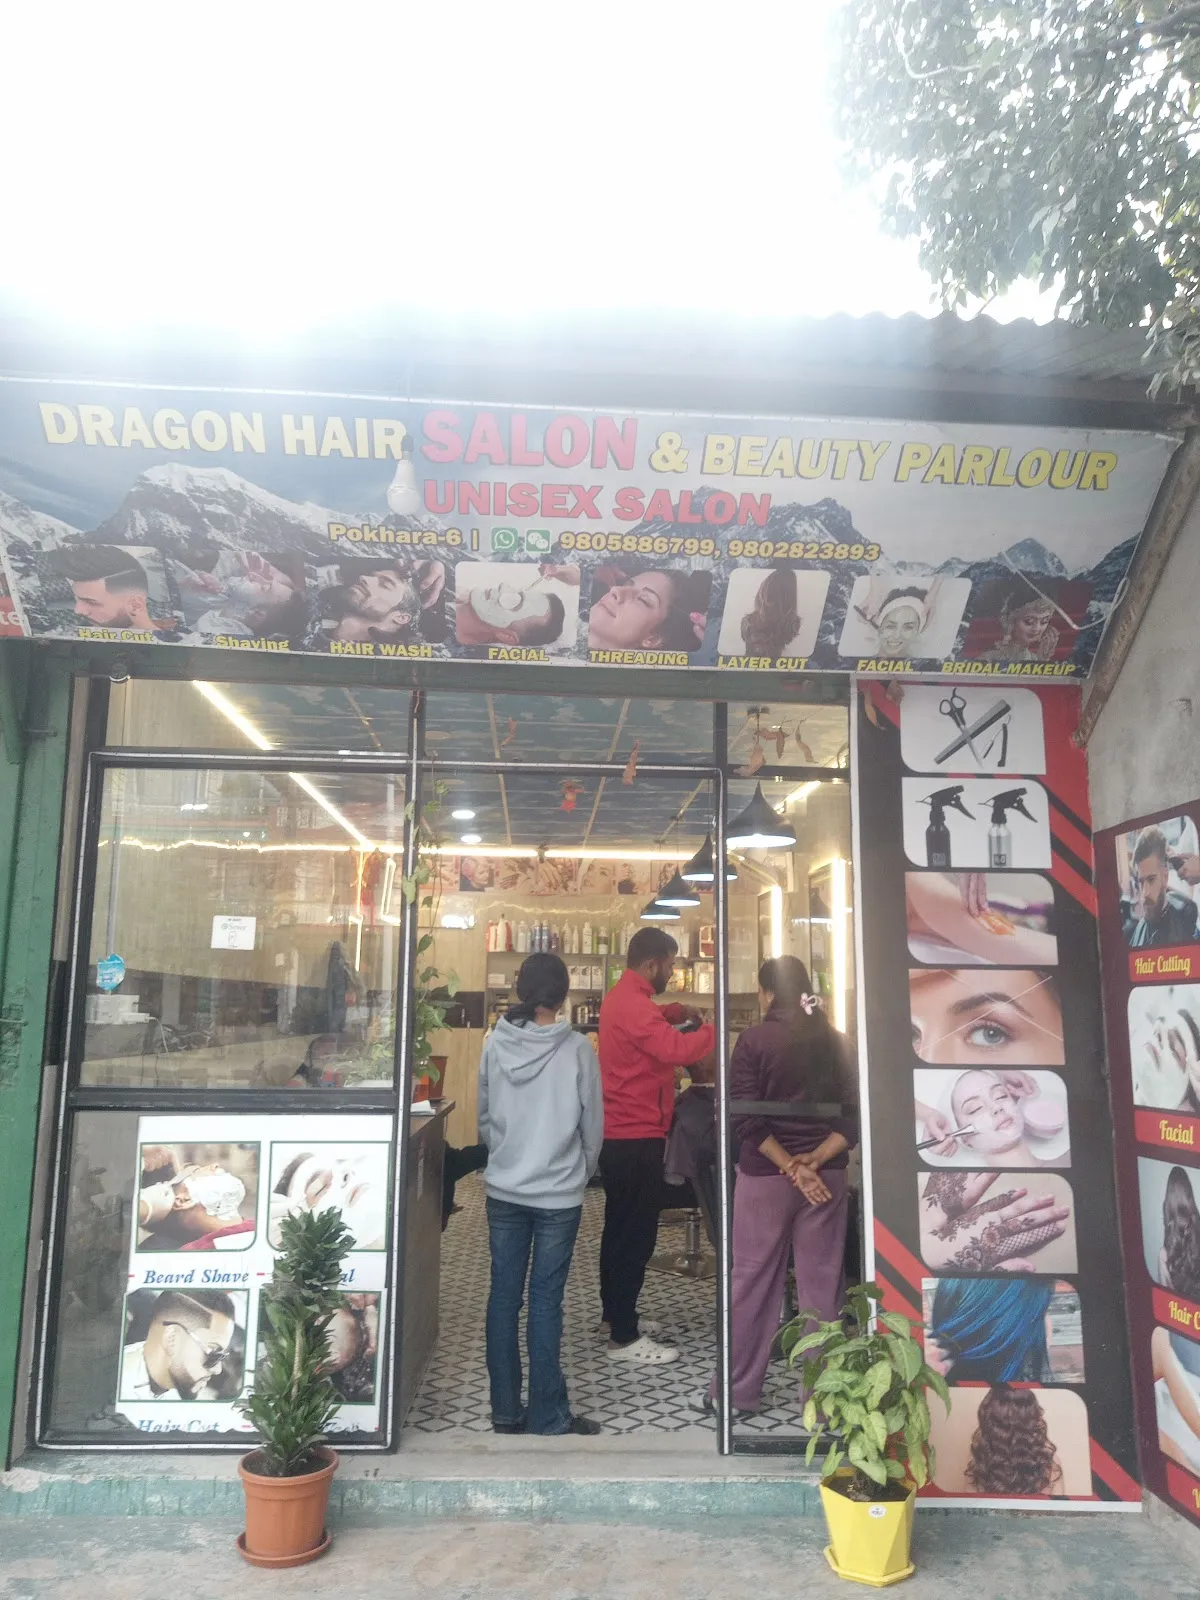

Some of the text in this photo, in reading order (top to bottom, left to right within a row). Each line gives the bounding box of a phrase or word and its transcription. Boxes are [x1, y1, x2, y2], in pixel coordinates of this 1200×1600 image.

[39, 402, 1118, 491] DRAGON HAIR SALON & BEAUTY PARLOUR
[423, 479, 772, 527] UNISEX SALON
[328, 522, 462, 546] Pokhara-6
[728, 540, 881, 562] 9802823893
[78, 627, 153, 643] Hair Cut
[215, 635, 290, 651] Shaving
[330, 641, 433, 657] HAIR WASH
[488, 647, 549, 661] FACIAL
[589, 650, 689, 665] THREADING
[717, 656, 809, 671] LAYER CUT
[857, 659, 914, 672] FACIAL
[941, 661, 1076, 676] BRIDAL MAKEUP
[1135, 957, 1156, 975] Hair
[1159, 1119, 1194, 1145] Facial
[142, 1269, 249, 1284] Beard Shave
[1168, 1300, 1193, 1326] Hair
